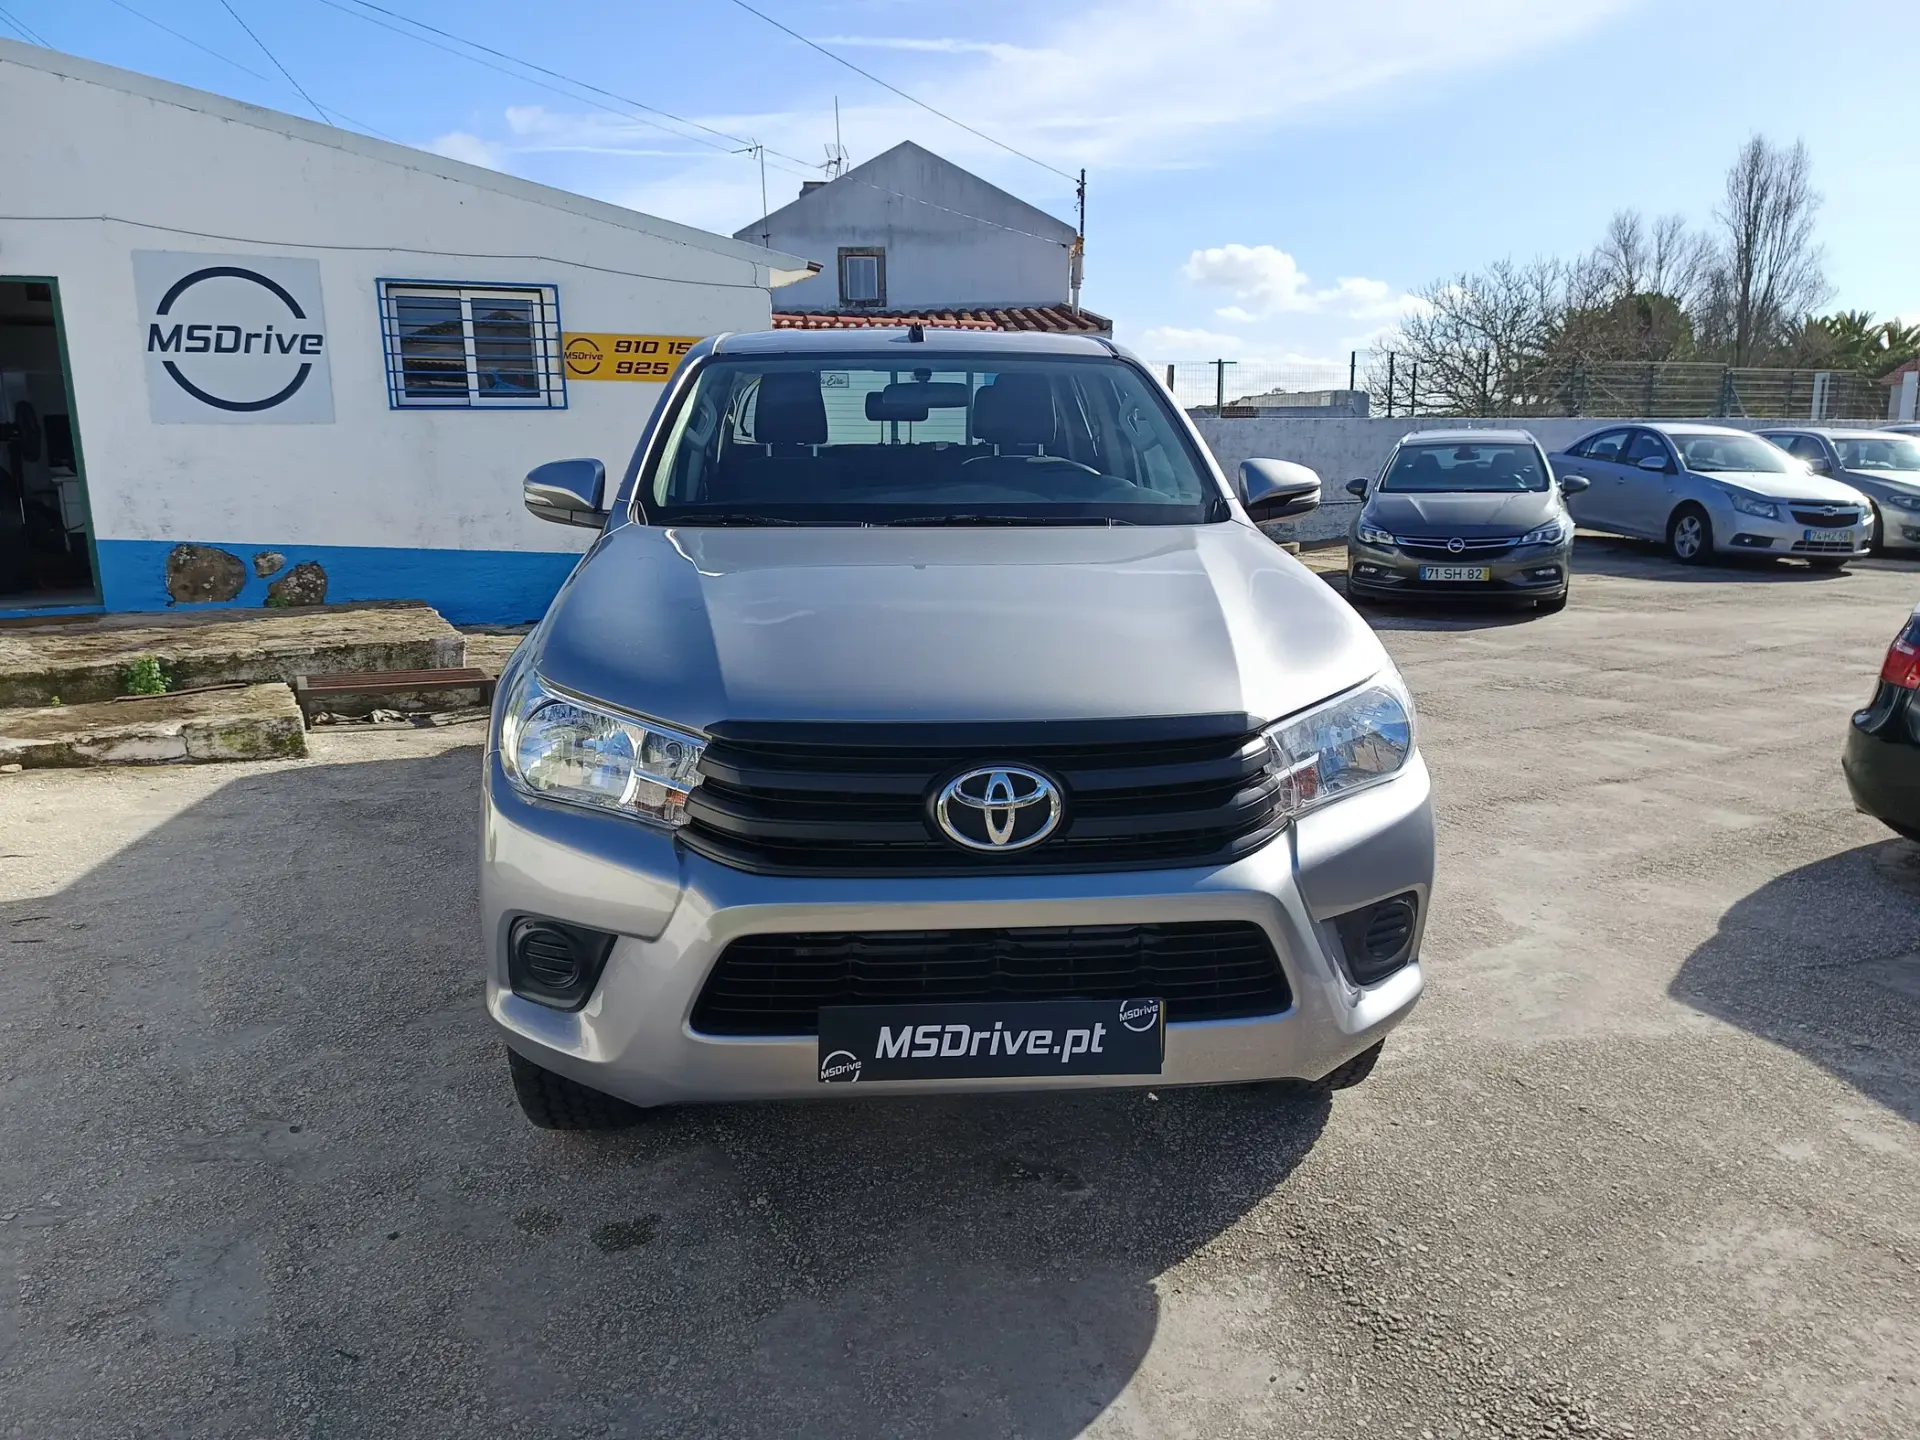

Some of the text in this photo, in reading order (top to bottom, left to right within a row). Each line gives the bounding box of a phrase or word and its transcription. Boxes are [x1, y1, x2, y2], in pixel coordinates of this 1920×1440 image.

[147, 323, 324, 355] MSDrive
[614, 340, 659, 354] 910
[563, 351, 603, 361] MSDrive
[615, 361, 669, 375] 925
[1119, 1002, 1158, 1022] MSDrive
[875, 1021, 1106, 1063] MSDrive.pt
[820, 1060, 862, 1080] MSDrive
